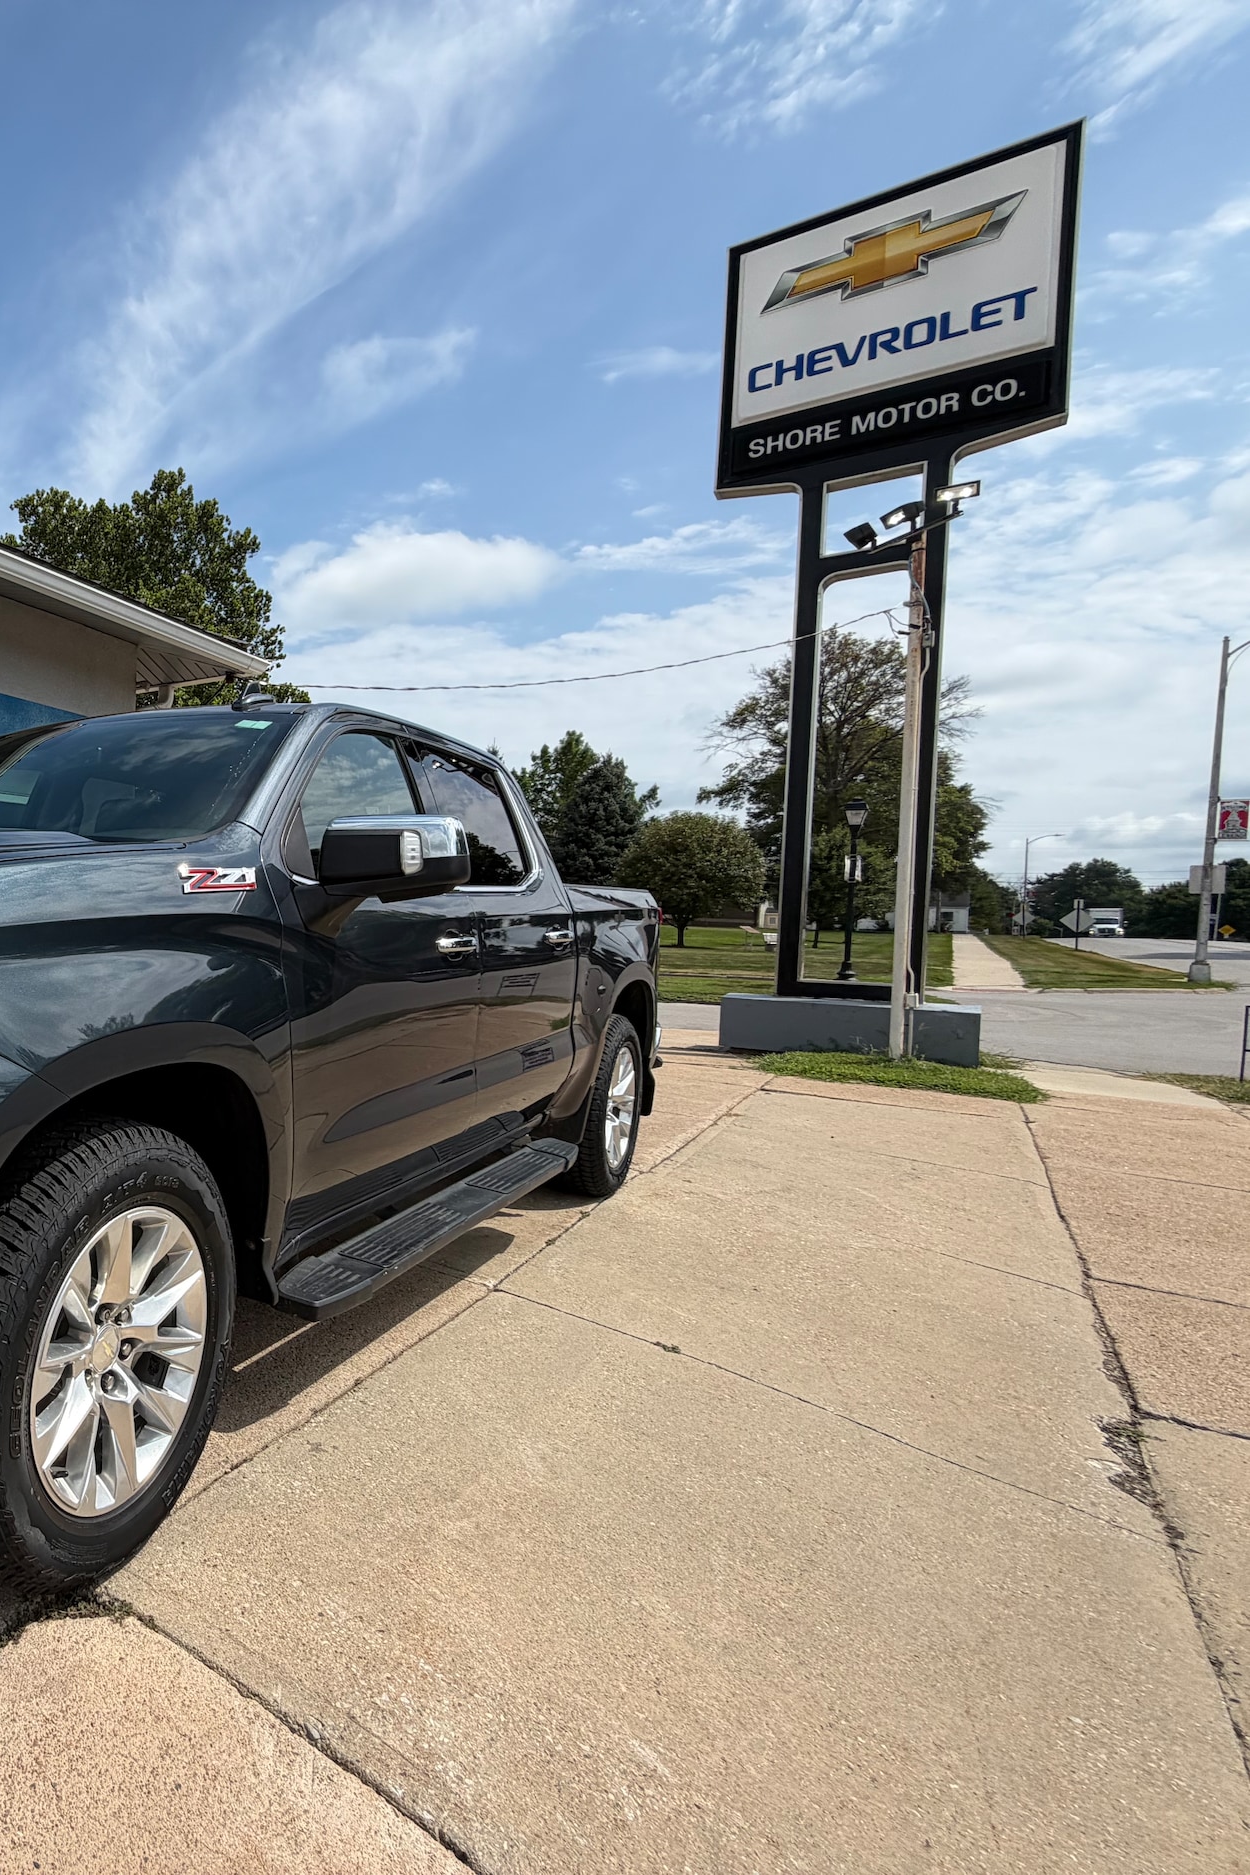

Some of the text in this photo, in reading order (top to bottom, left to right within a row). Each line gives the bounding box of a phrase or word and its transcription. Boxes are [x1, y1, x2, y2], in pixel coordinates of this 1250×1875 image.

[748, 286, 1038, 393] CHEVROLET
[748, 378, 1027, 458] SHORE MOTOR CO.
